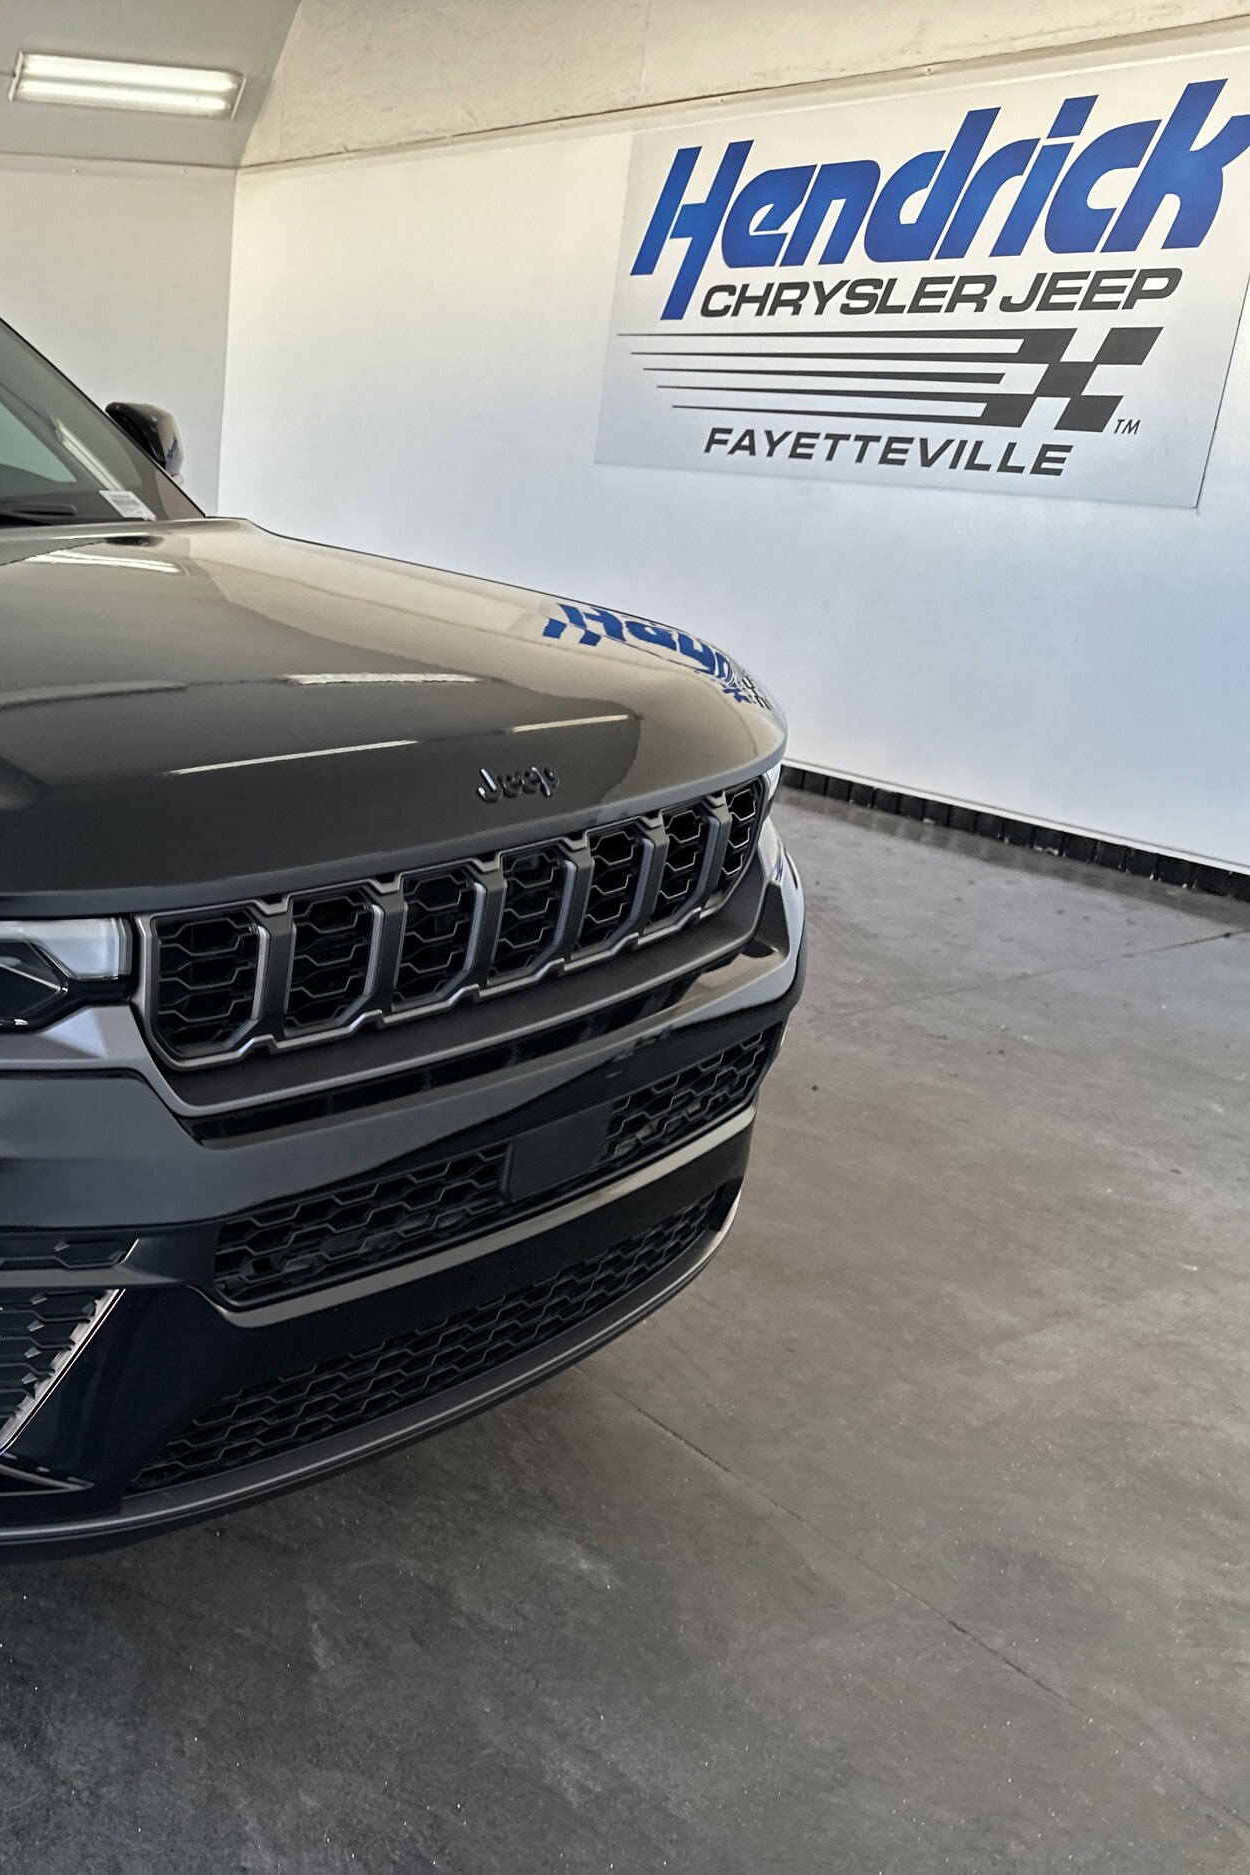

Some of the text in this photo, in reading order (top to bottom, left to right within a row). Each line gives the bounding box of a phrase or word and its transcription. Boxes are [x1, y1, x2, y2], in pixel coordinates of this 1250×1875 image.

[630, 78, 1250, 321] Hendrick
[700, 267, 1183, 318] CHRYSLER JEEP
[703, 427, 1074, 477] FAYETTEVILLE
[1114, 417, 1141, 437] TM
[477, 766, 559, 803] Jeep
